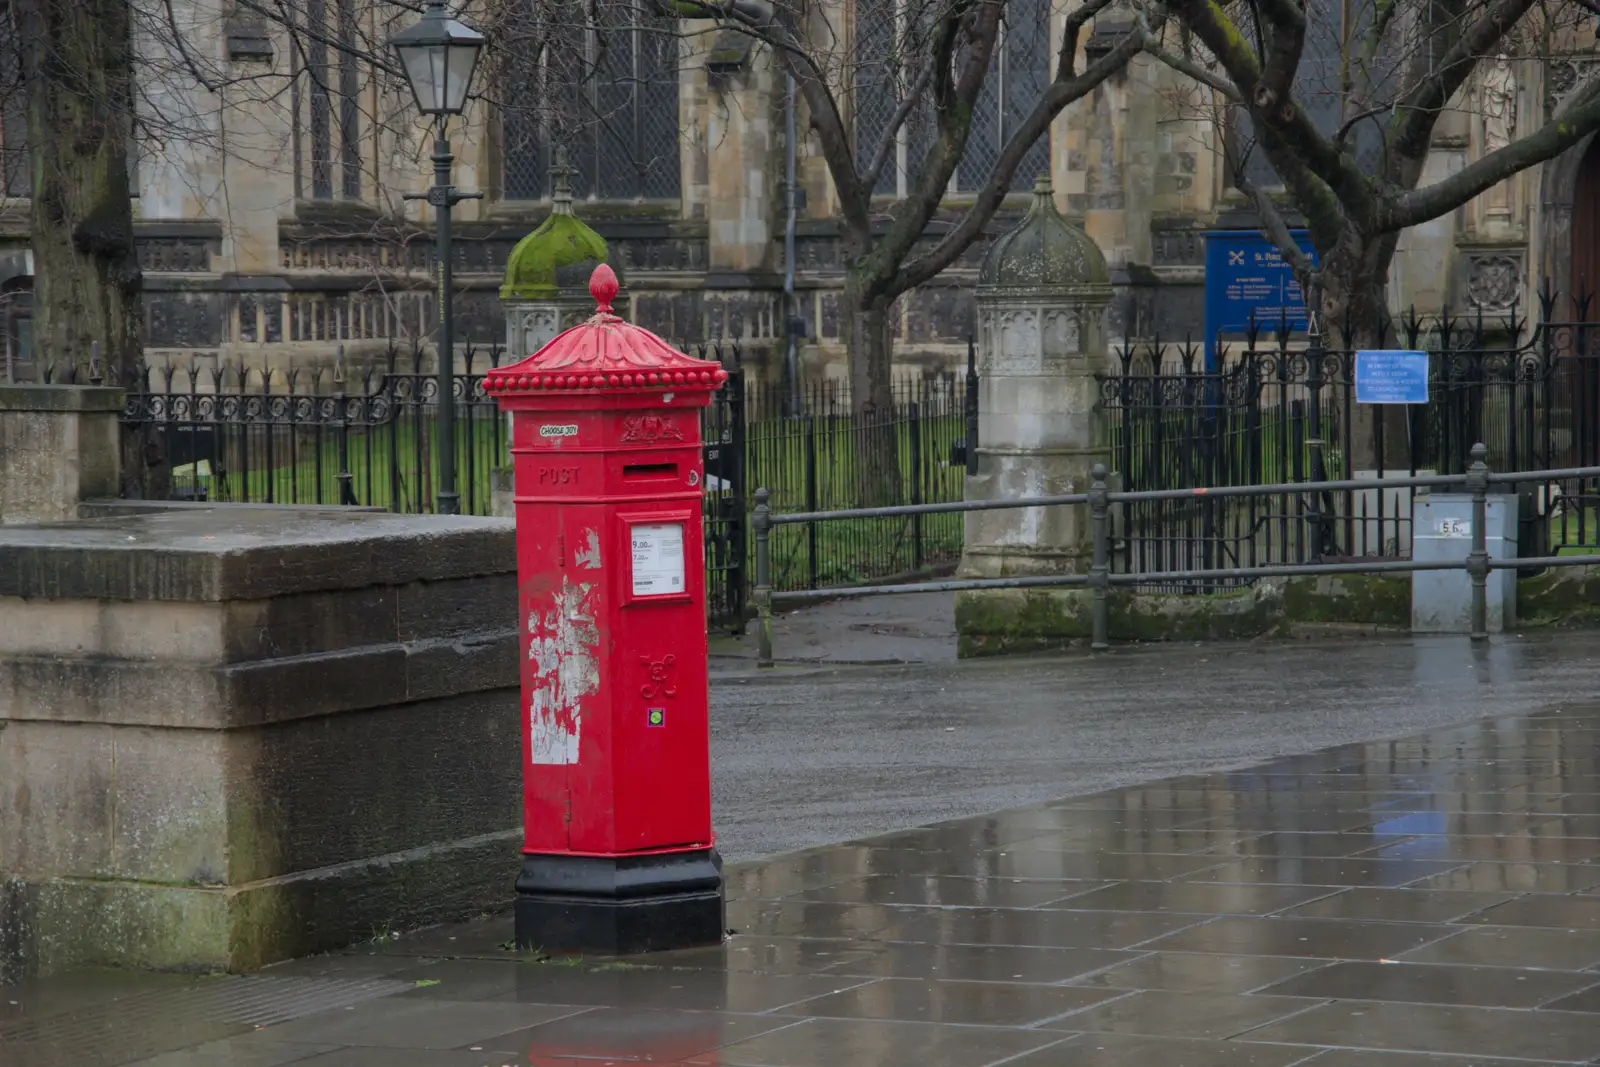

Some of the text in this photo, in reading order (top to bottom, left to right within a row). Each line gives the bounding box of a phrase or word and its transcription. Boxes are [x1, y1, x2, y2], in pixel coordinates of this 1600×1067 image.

[541, 426, 577, 435] CHOOSE JOY
[539, 466, 581, 485] POST
